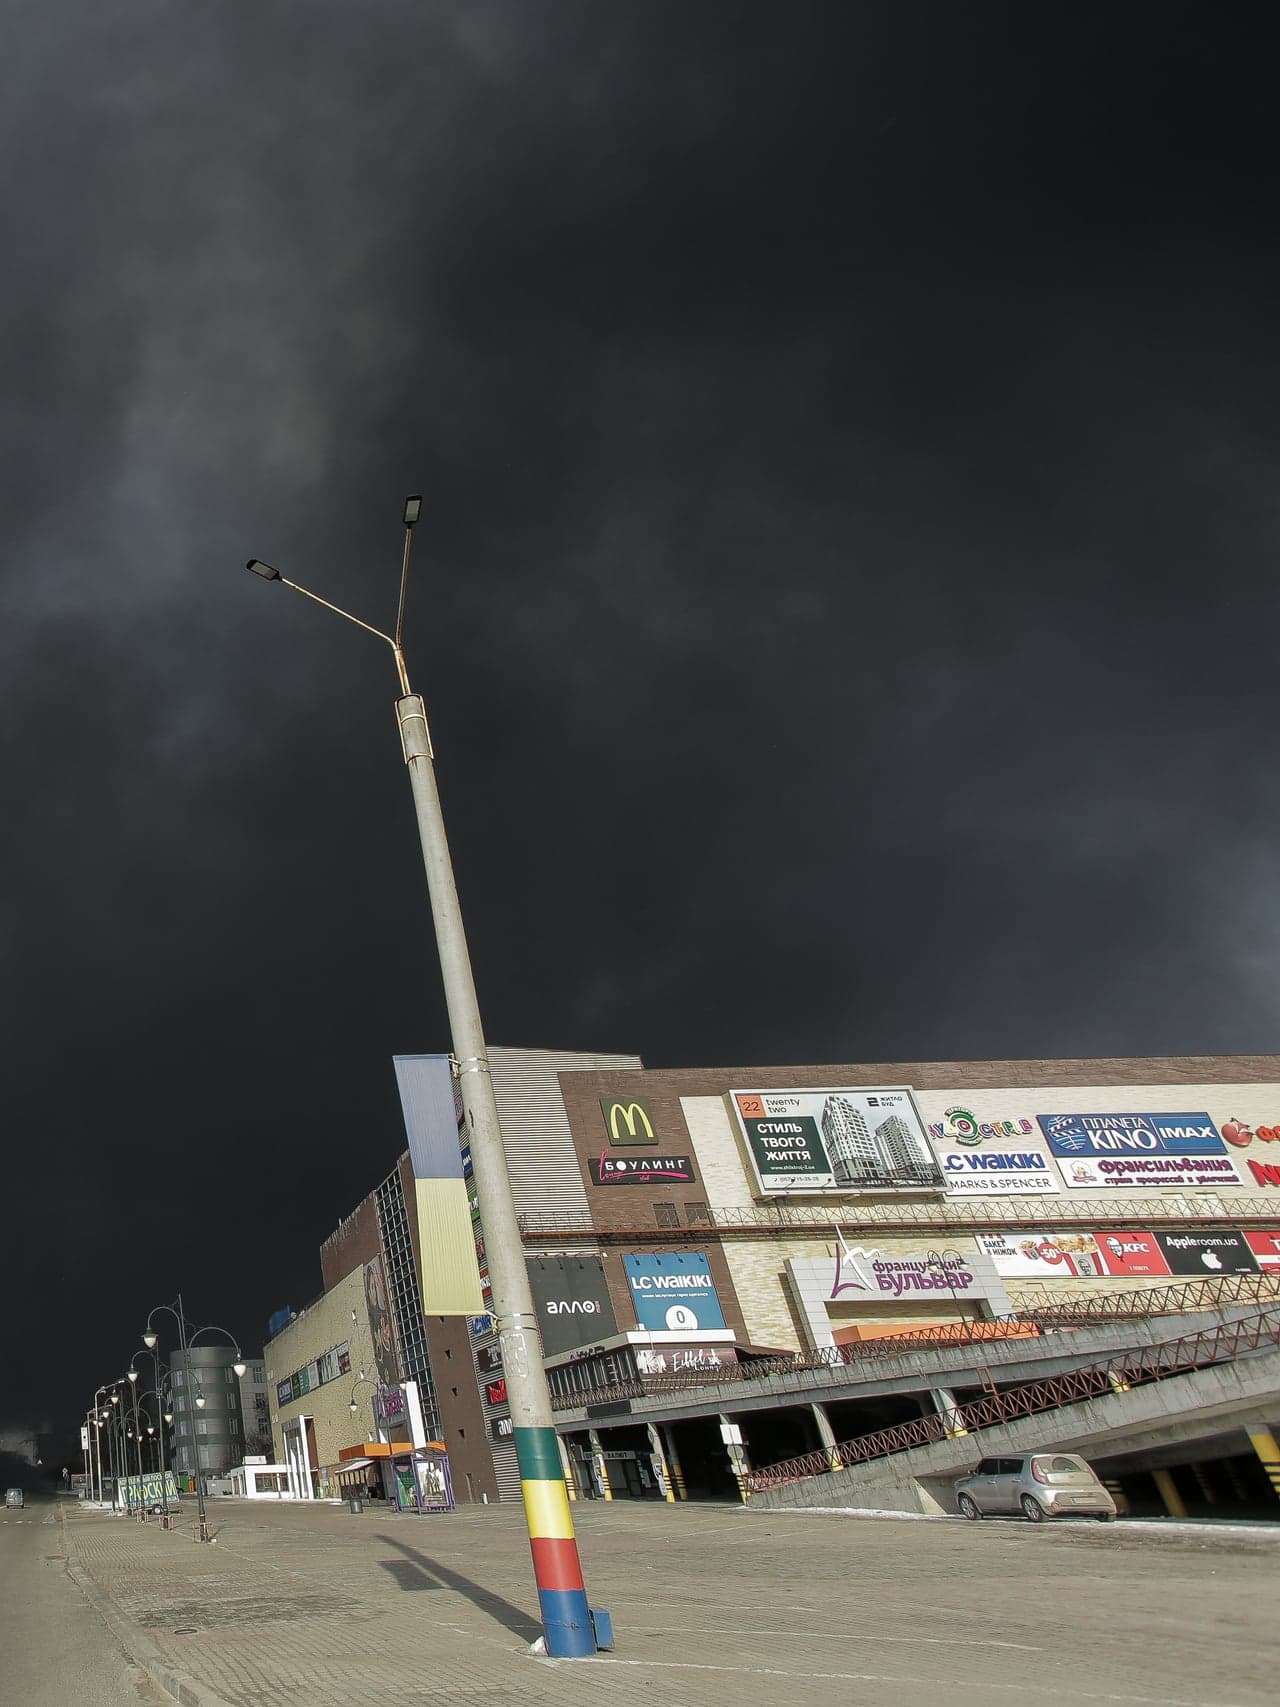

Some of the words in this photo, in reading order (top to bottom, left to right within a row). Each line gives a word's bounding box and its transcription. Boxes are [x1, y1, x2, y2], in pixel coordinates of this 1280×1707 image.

[743, 1101, 761, 1112] 22
[766, 1098, 800, 1106] twenty
[757, 1123, 802, 1134] СТИЛЬ
[1159, 1127, 1216, 1138] IMAX
[760, 1137, 806, 1147] ТВОГО
[1086, 1129, 1158, 1150] KINO
[765, 1151, 812, 1161] ЖИТТЯ
[604, 1160, 685, 1171] БОУЛИНГ
[949, 1179, 989, 1190] MARKS
[990, 1179, 999, 1189] &
[1002, 1178, 1052, 1188] SPENCER
[983, 1240, 1007, 1248] БАКЕТ
[1166, 1236, 1239, 1248] Appleroom.ua
[1123, 1243, 1151, 1253] KFC
[631, 1276, 652, 1289] LC
